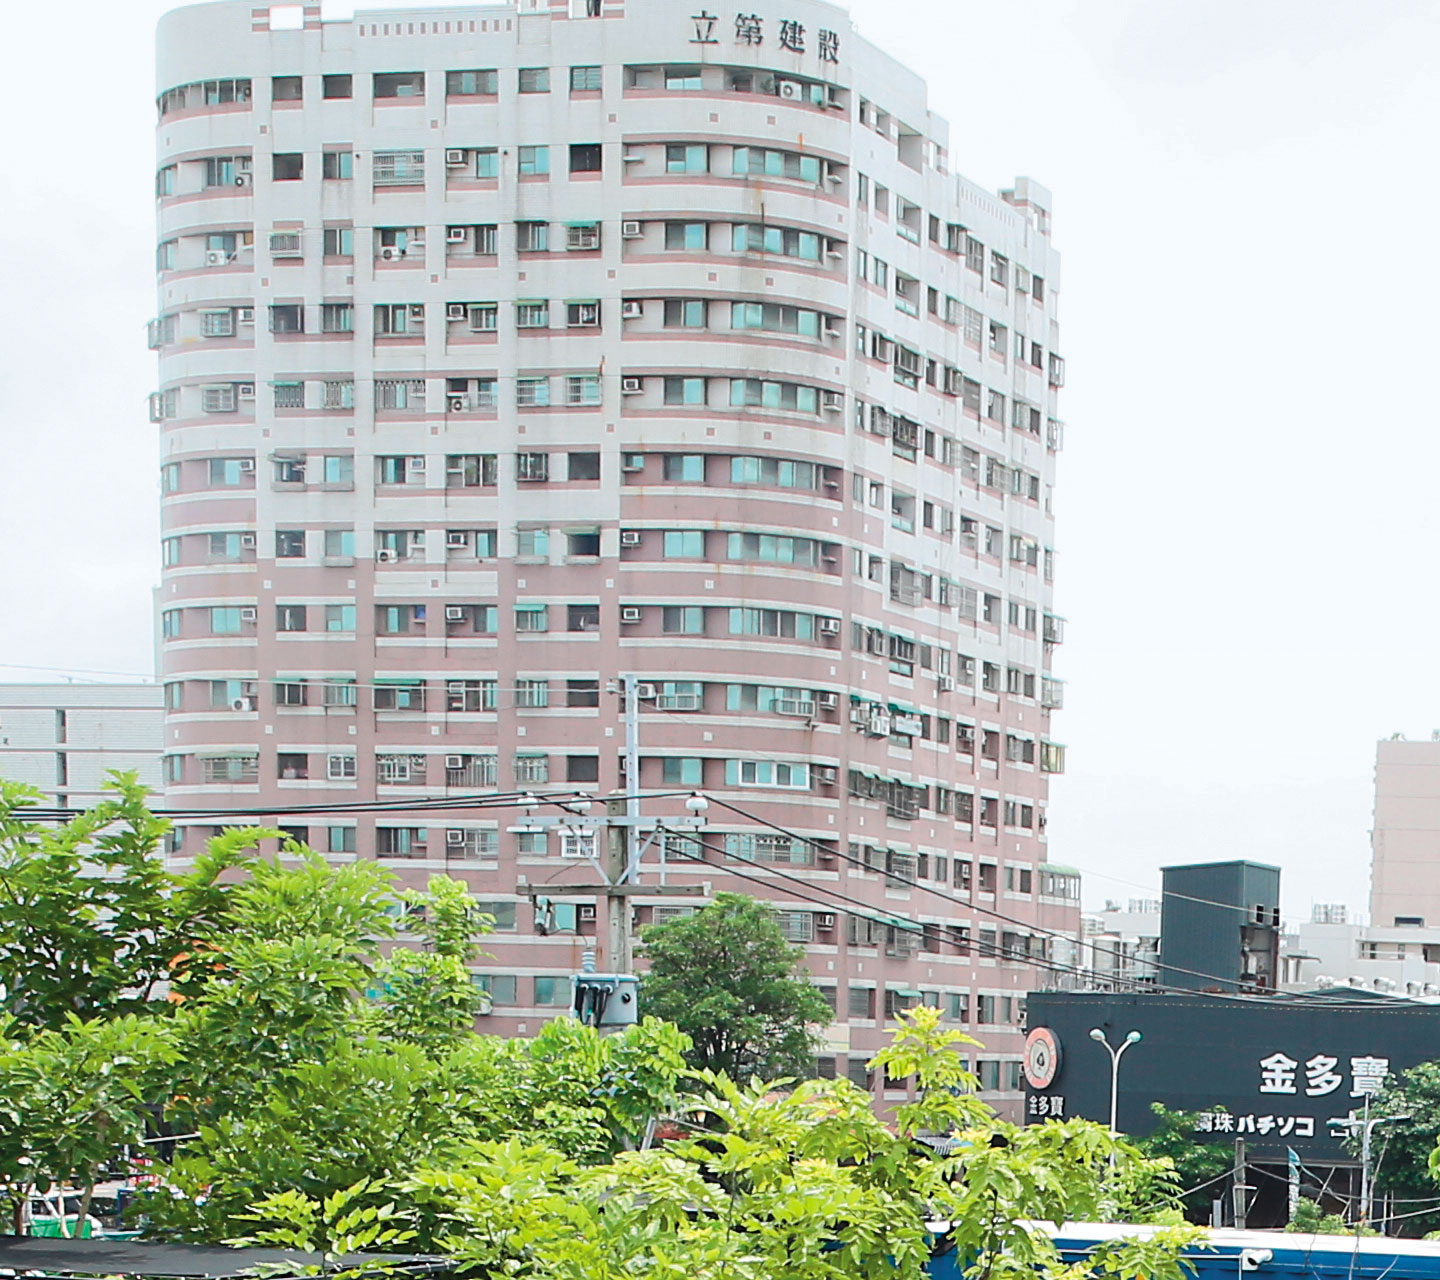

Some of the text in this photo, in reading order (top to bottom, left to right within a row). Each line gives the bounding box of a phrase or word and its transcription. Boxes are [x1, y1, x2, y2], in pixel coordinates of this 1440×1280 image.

[1259, 1052, 1390, 1098] 金多寶
[1029, 1095, 1064, 1117] 金多寶
